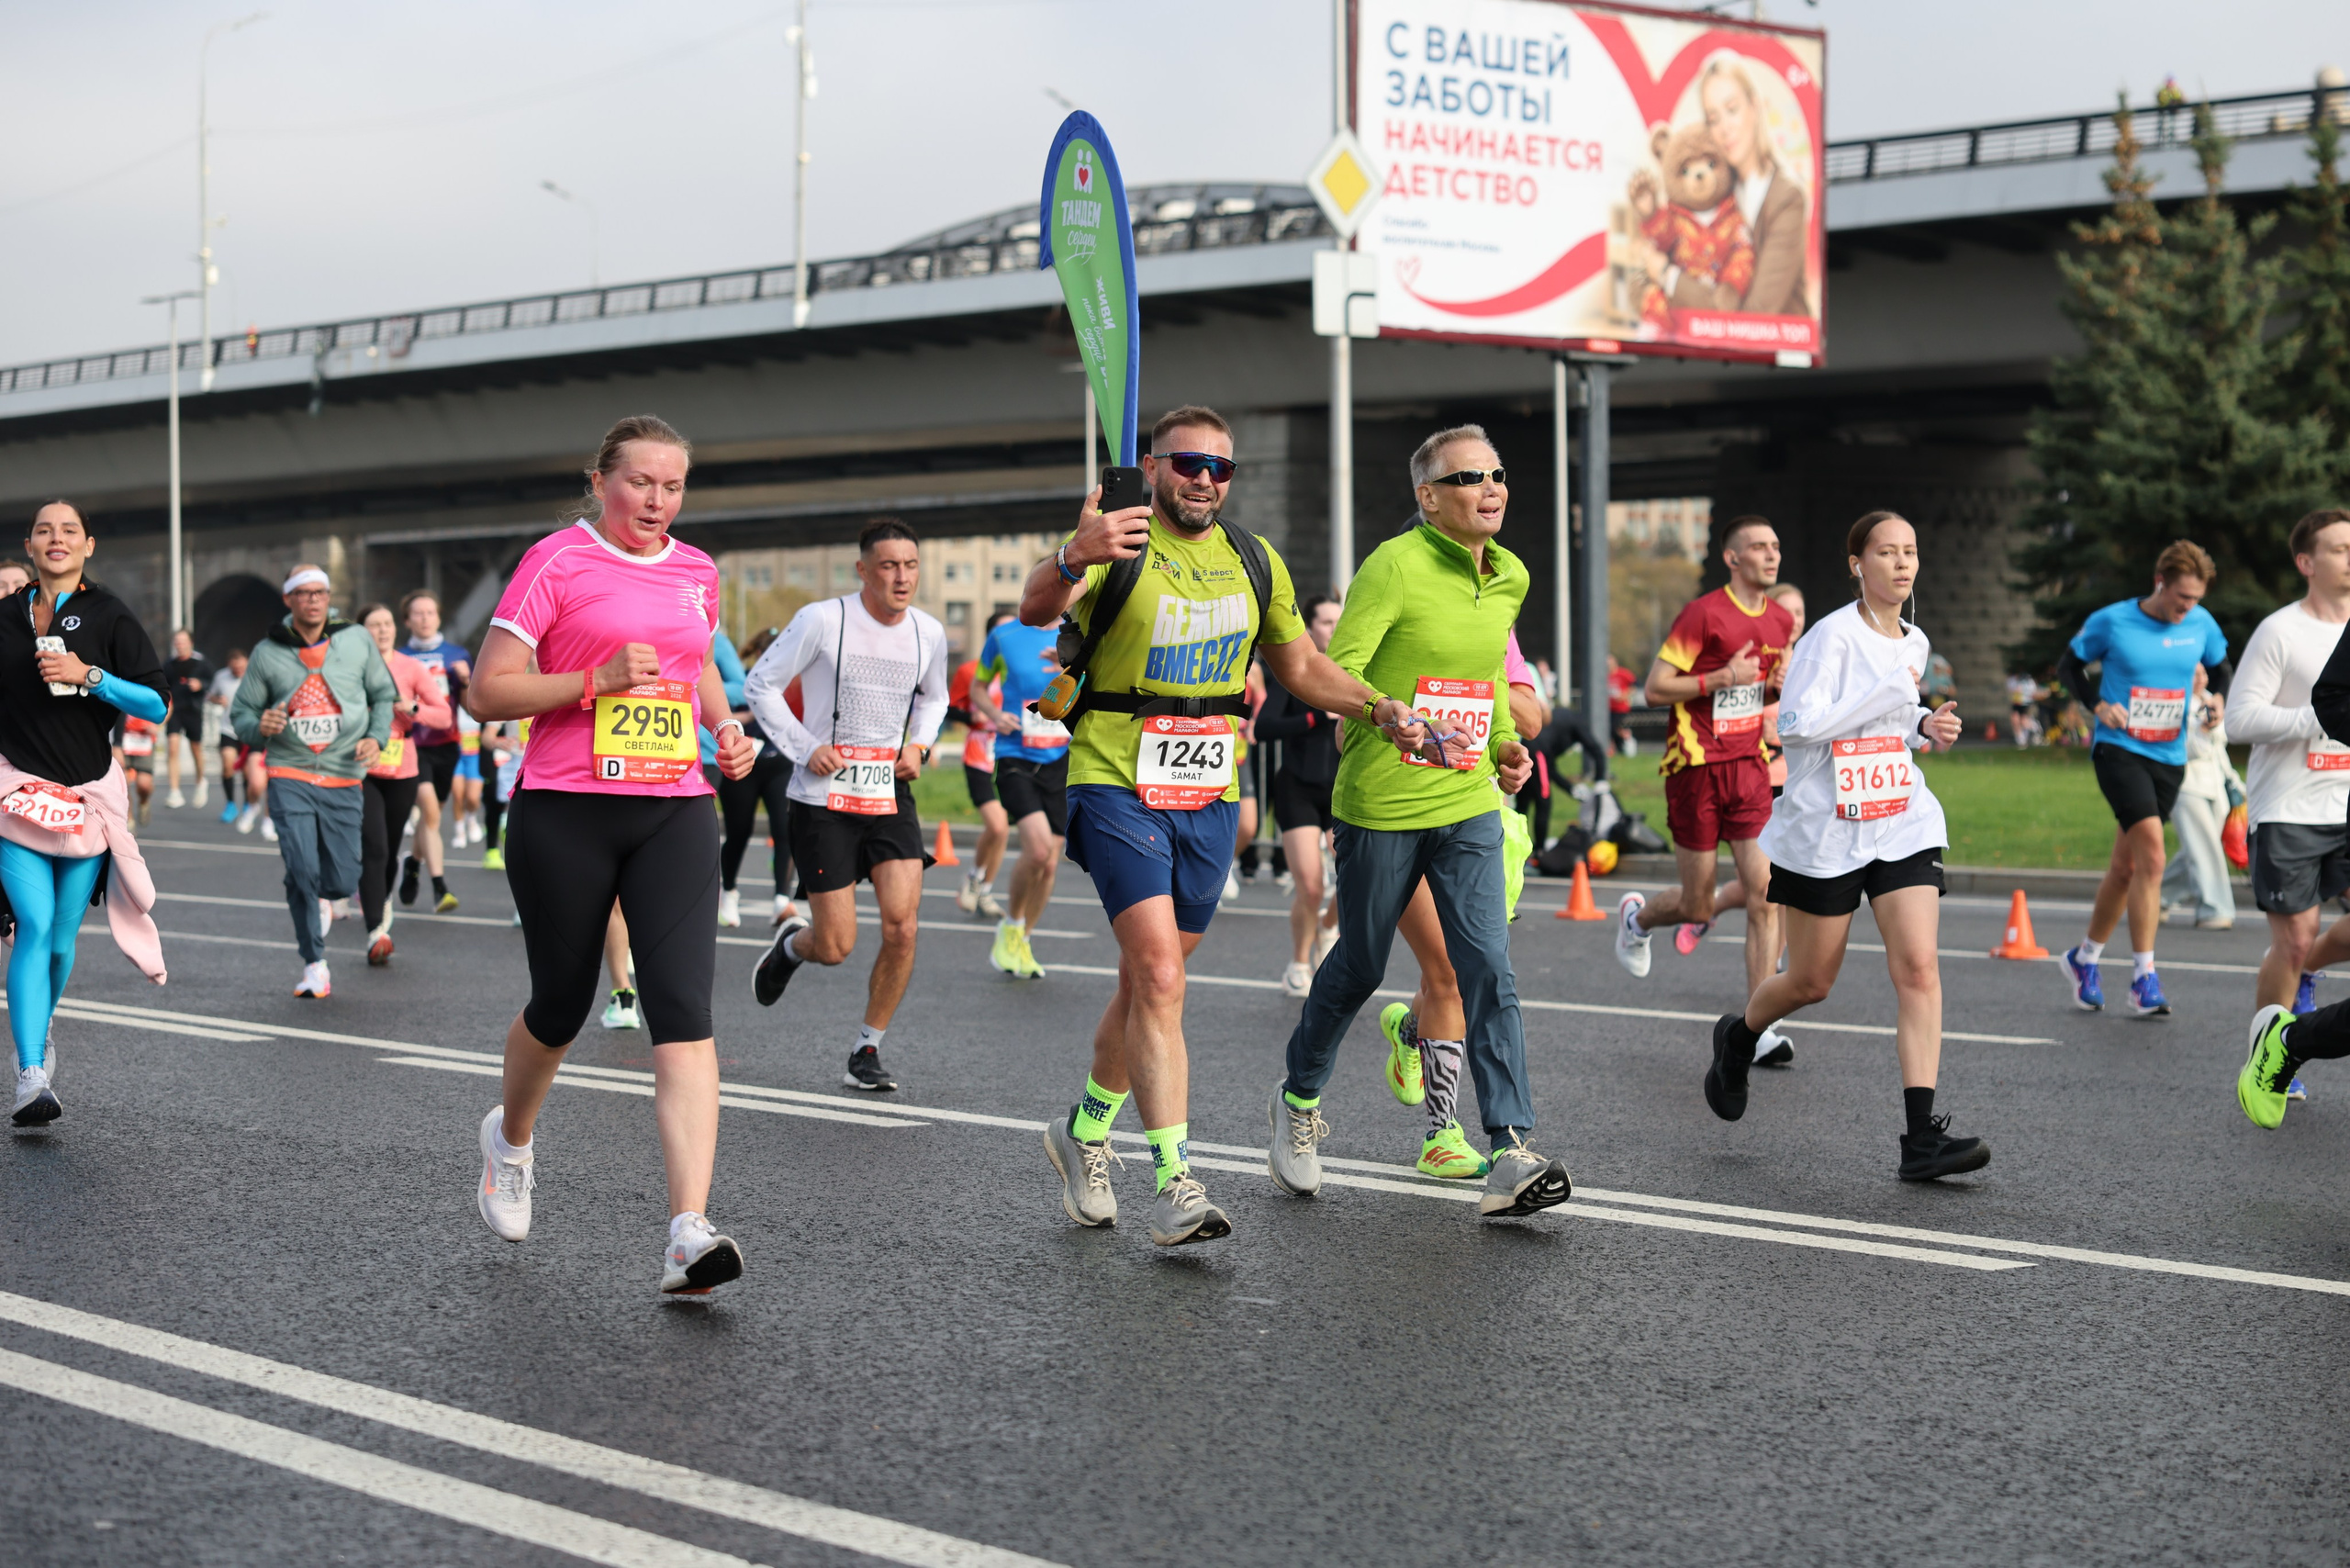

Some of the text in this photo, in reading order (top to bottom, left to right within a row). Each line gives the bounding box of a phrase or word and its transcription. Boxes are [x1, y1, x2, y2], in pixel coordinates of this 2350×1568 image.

[1386, 21, 1570, 80] С ВАШЕЙ
[1386, 69, 1551, 125] ЗАБОТЫ
[1383, 119, 1604, 173] НАЧИНАЕТСЯ
[1382, 162, 1539, 207] ДЕТСТВО
[1061, 200, 1102, 229] ТАНДЕМ
[1096, 275, 1116, 330] ЖИВИ
[1150, 592, 1248, 645] БЕЖИМ
[1144, 630, 1248, 685] ВМЕСТЕ
[1043, 685, 1060, 703] JBL
[1718, 687, 1762, 708] 25391
[2132, 701, 2184, 720] 24772
[293, 718, 341, 734] 17631
[610, 704, 683, 739] 2950
[1718, 720, 1729, 734] D
[624, 740, 675, 752] СВЕТЛАНА
[1157, 741, 1225, 769] 1243
[607, 760, 621, 777] D
[2314, 755, 2324, 769] D
[834, 765, 891, 785] 21708
[1170, 771, 1203, 780] SAMAT
[1839, 763, 1912, 792] 31612
[834, 795, 845, 809] D
[1146, 788, 1158, 805] C
[1848, 803, 1858, 817] D
